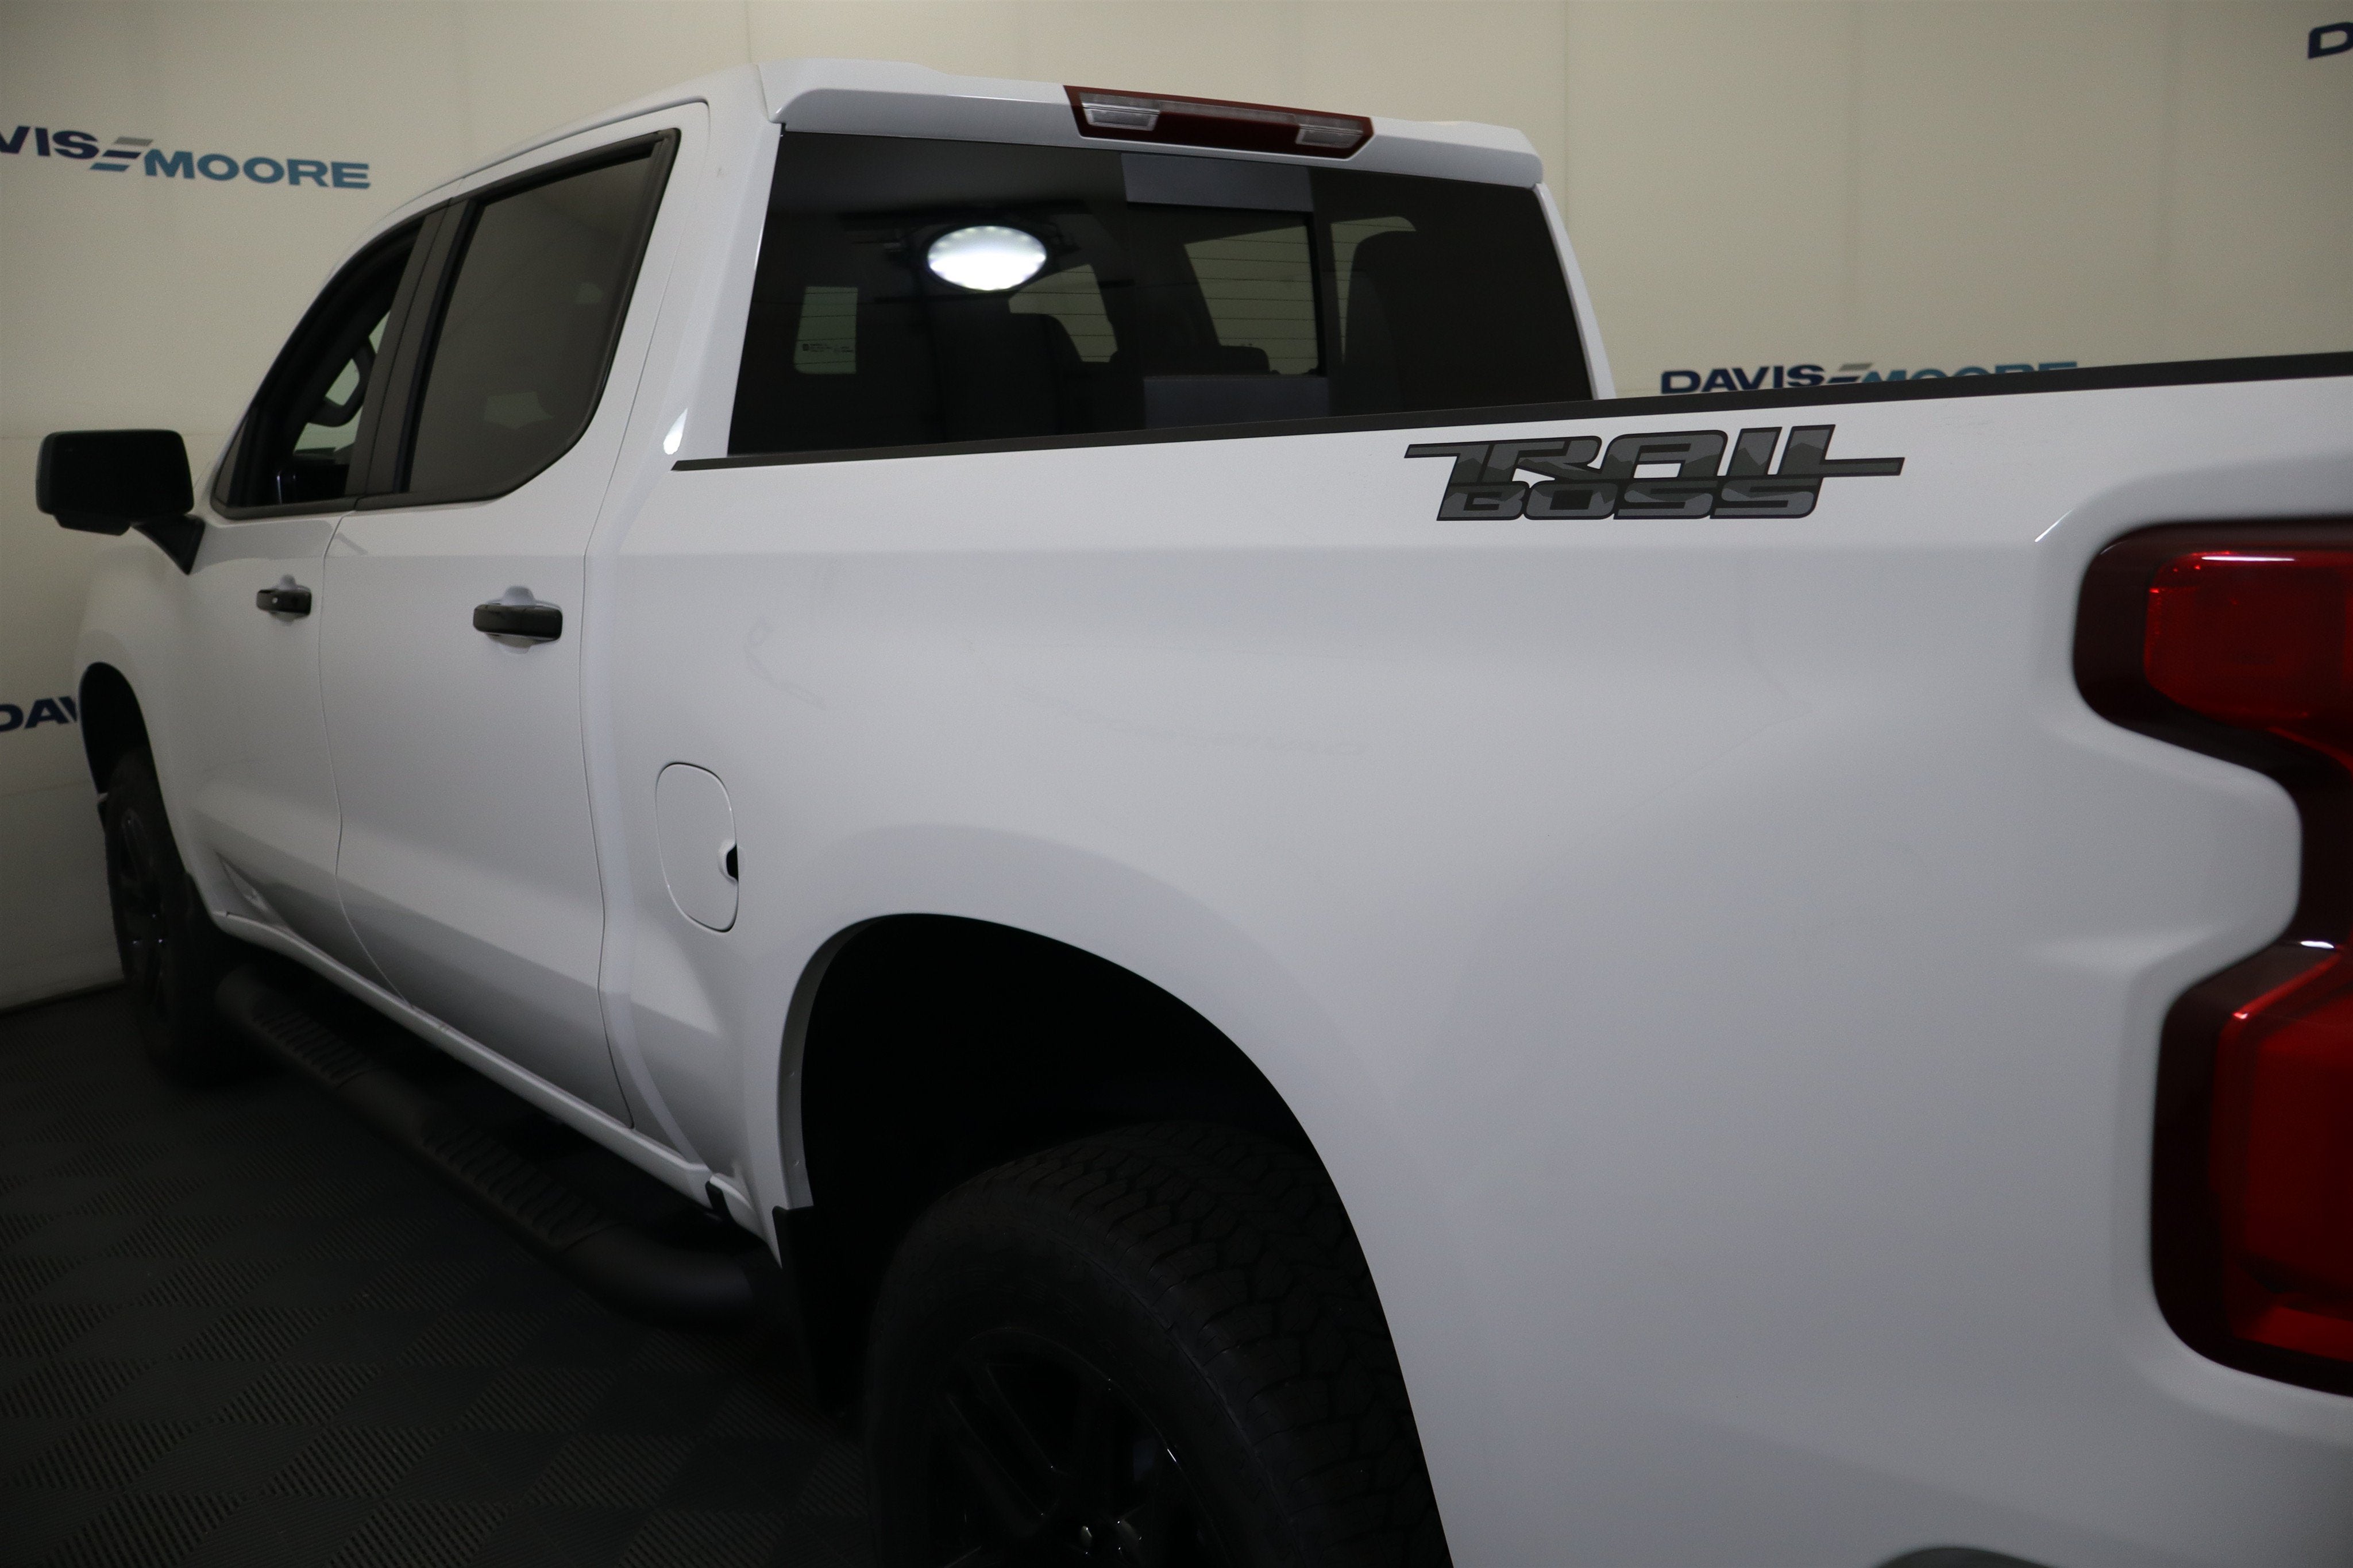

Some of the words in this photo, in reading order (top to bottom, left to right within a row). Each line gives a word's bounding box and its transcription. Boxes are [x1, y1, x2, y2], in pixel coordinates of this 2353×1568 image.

[144, 149, 371, 190] MOORE
[1661, 364, 1824, 395] DAVIS
[1404, 424, 1905, 482] TRAIL
[1436, 477, 1824, 521] BOSS
